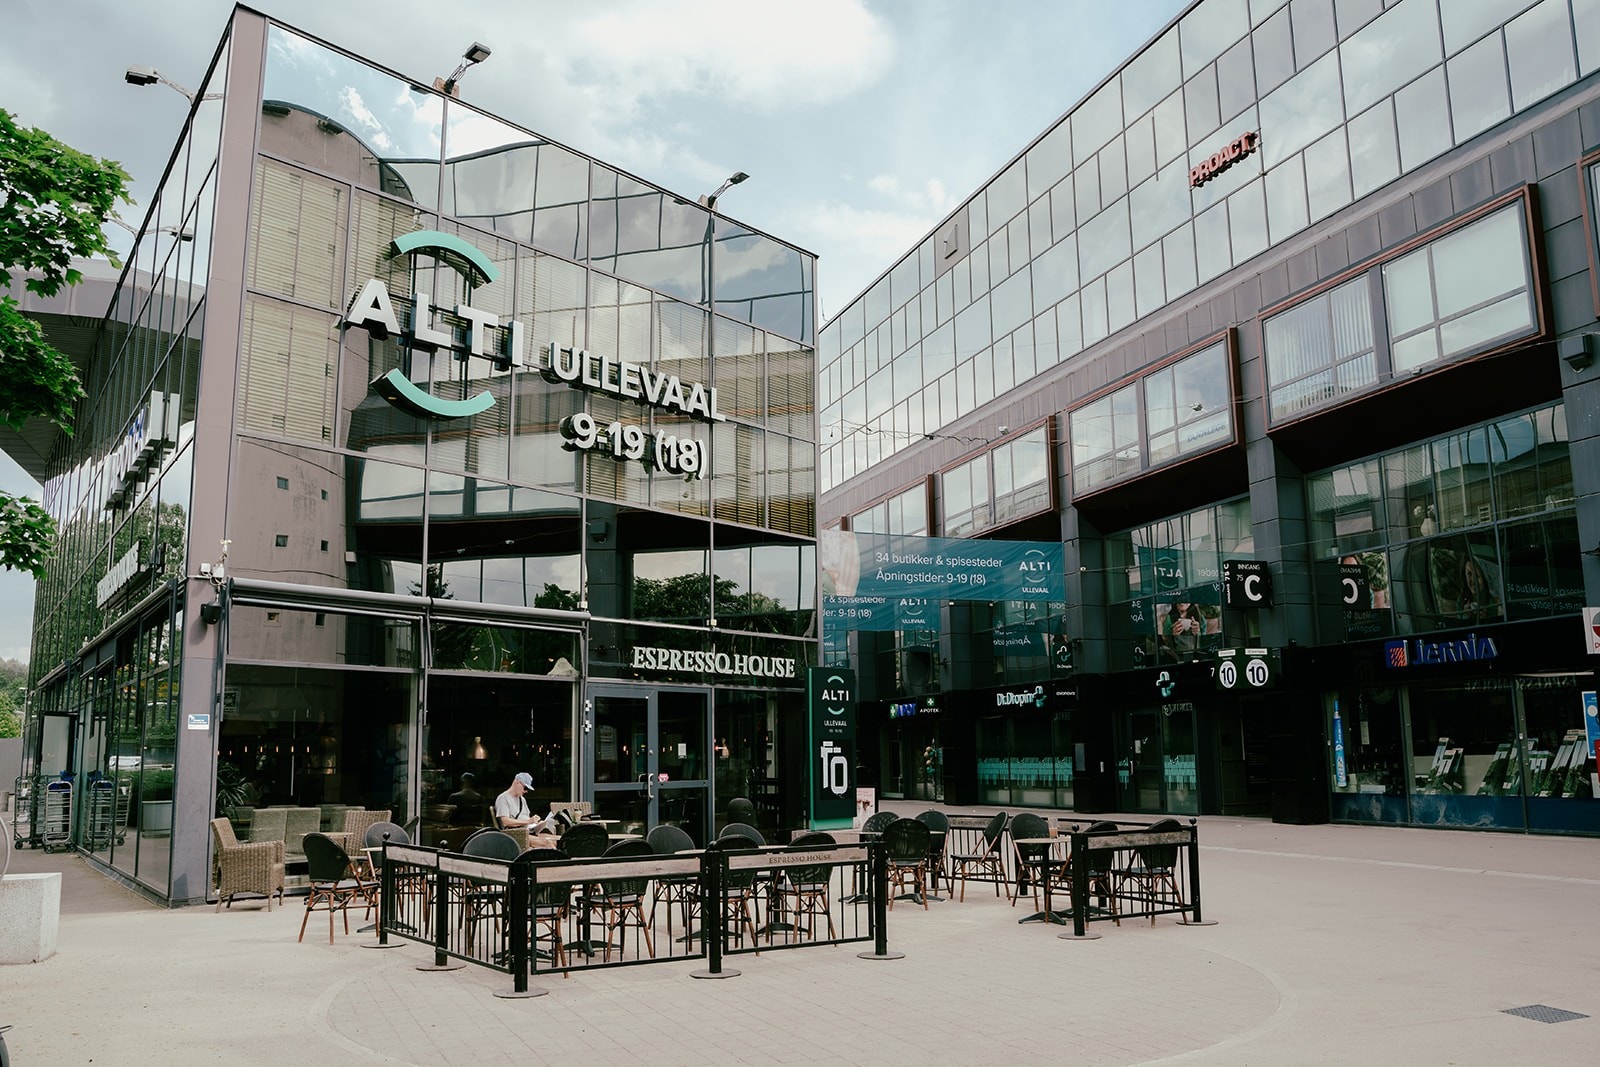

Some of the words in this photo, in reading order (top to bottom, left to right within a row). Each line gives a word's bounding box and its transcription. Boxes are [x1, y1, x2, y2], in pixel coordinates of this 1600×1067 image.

[1189, 132, 1255, 187] PROACT
[345, 278, 524, 368] ALTI
[548, 341, 726, 422] ULLEVAAL
[569, 413, 645, 461] 9-19
[654, 429, 707, 481] (18)
[876, 552, 889, 563] 34
[892, 553, 933, 565] butikker
[936, 555, 943, 565] &
[946, 556, 1002, 568] spisesteder
[1019, 561, 1050, 571] ALTI
[876, 567, 944, 584] Åpningstider:
[946, 573, 967, 584] 9-19
[970, 574, 986, 586] (18)
[1244, 574, 1263, 601] C
[900, 598, 927, 606] ALTI
[838, 608, 856, 617] 9-19
[858, 609, 872, 618] (18)
[632, 646, 734, 675] ESPRESSO
[734, 654, 796, 678] HOUSE
[1248, 665, 1266, 684] 10
[822, 689, 849, 701] ALTI
[769, 855, 805, 864] ESPRESSO
[807, 854, 831, 862] HOUSE
